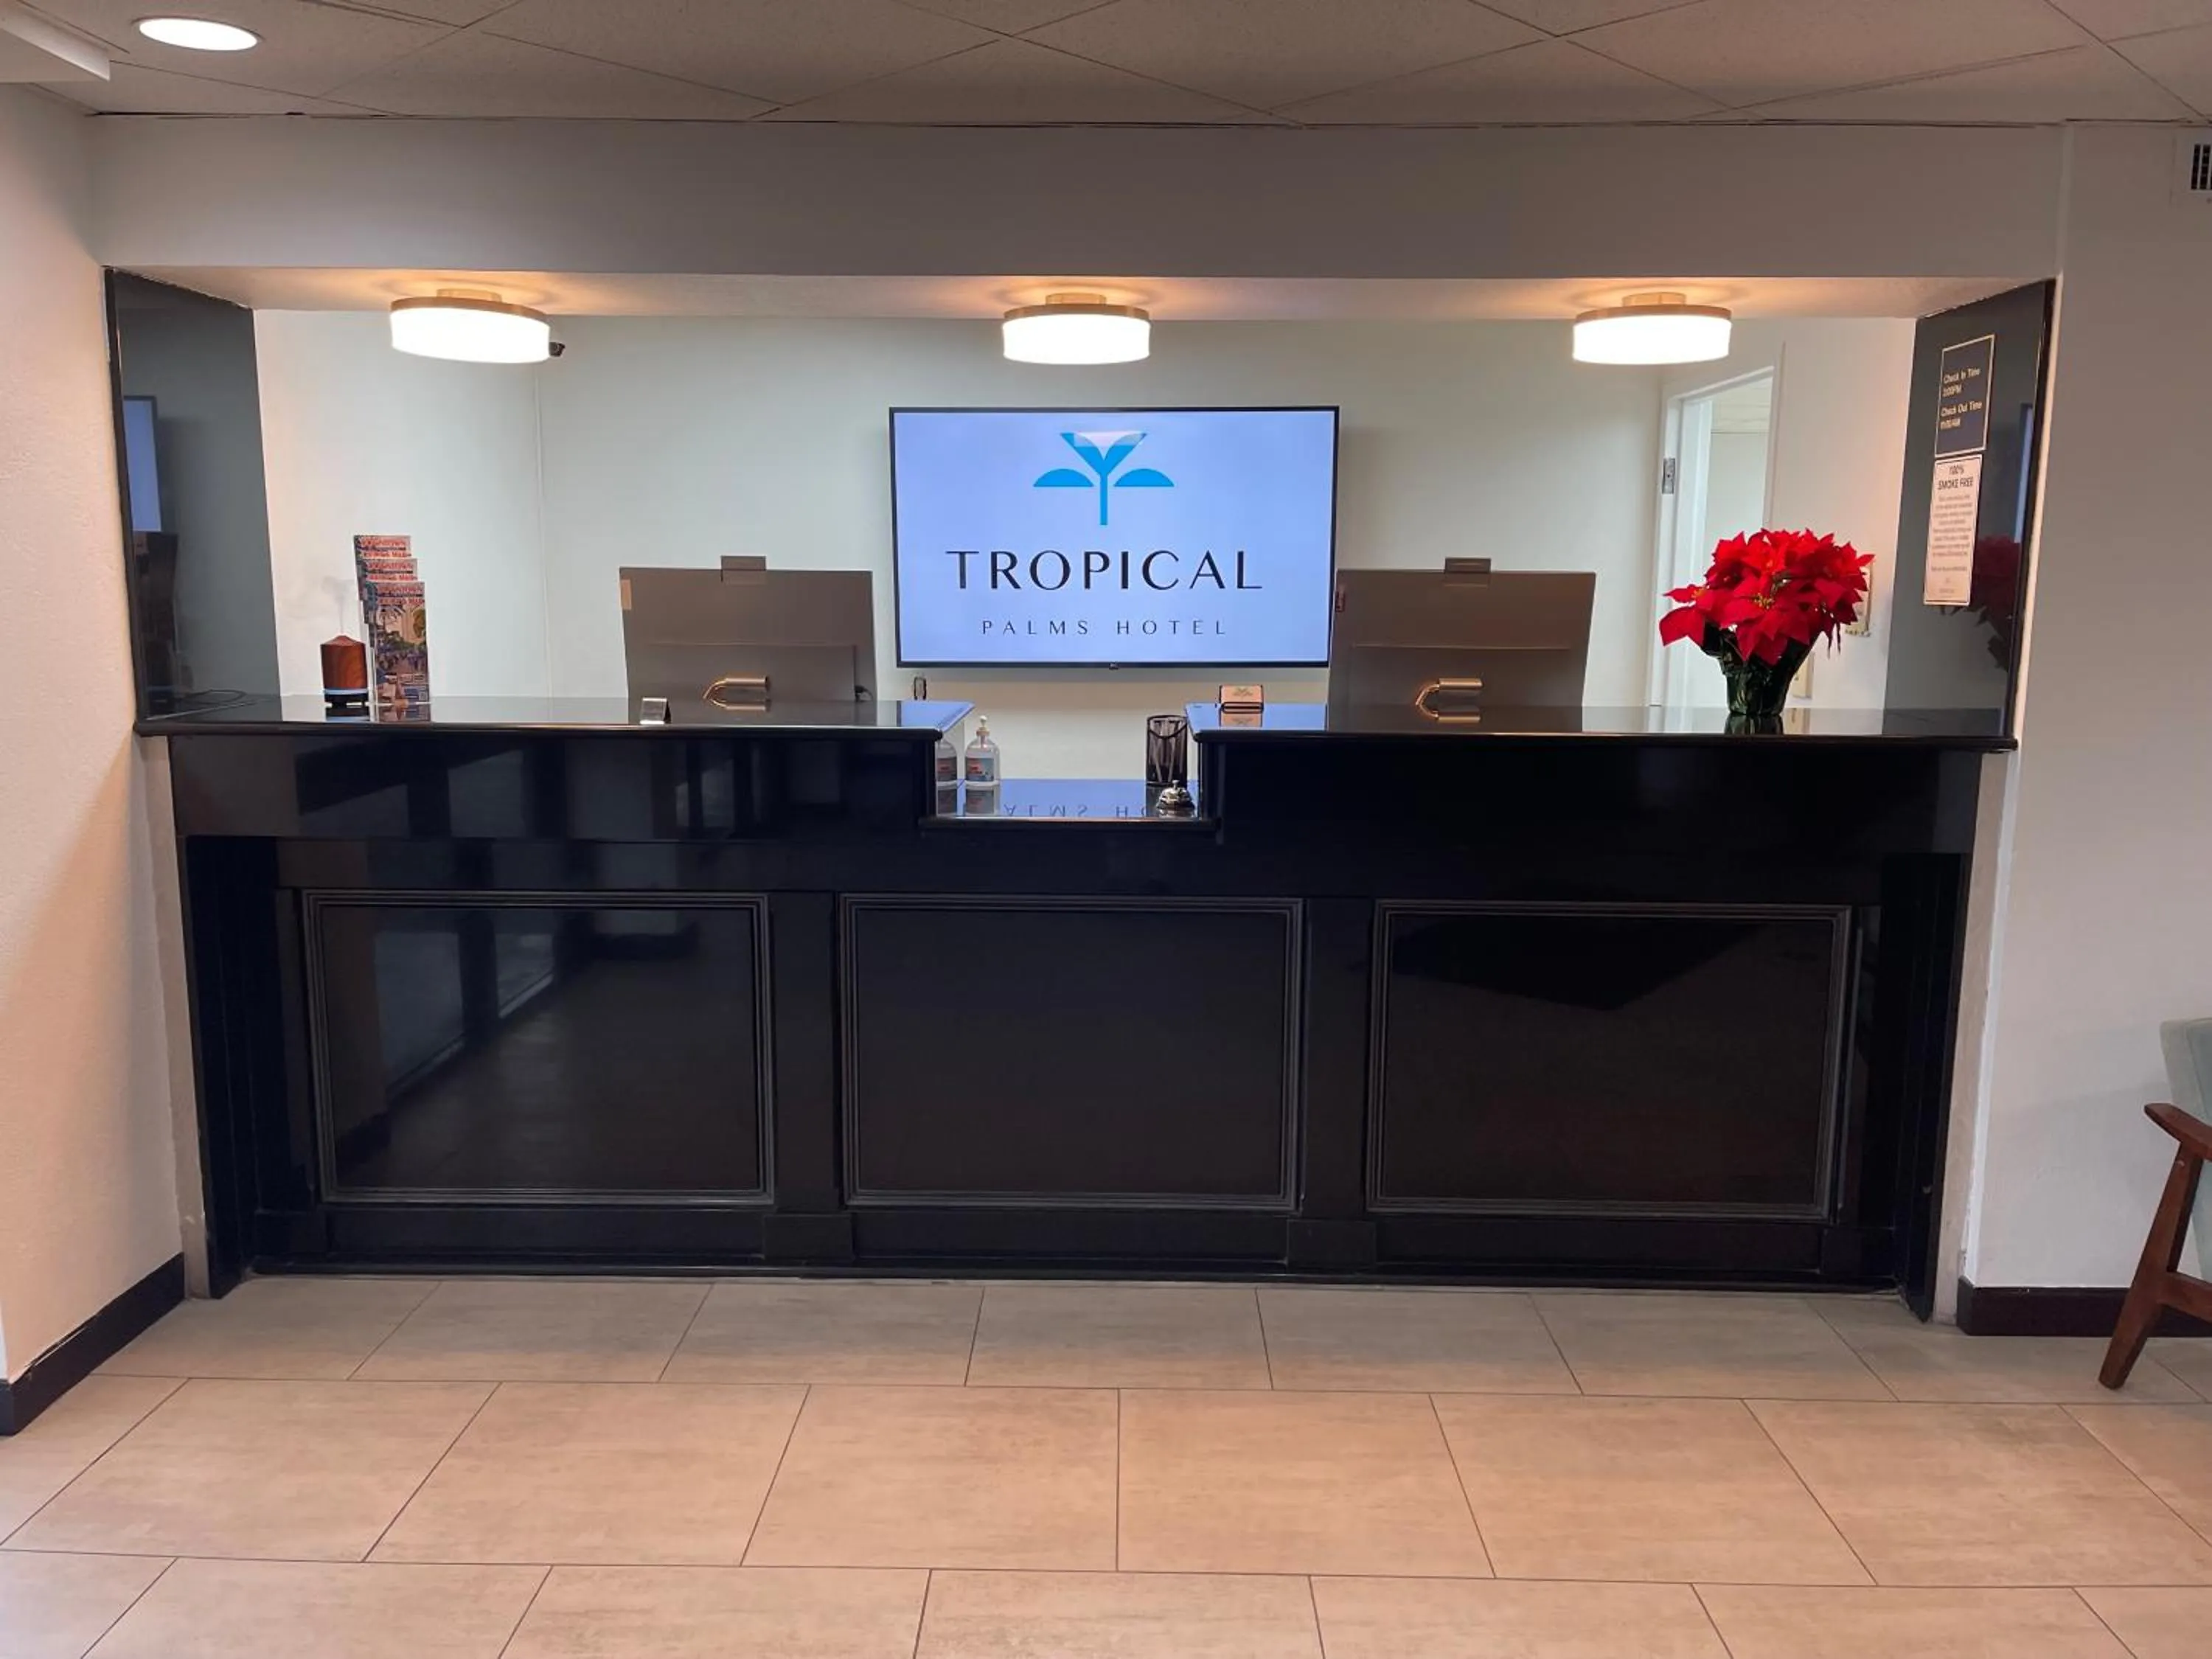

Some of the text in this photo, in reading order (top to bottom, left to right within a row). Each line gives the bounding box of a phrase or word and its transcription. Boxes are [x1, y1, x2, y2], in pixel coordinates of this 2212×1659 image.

[1942, 368, 1981, 383] Check In Time
[1941, 400, 1982, 417] Check Out Time
[1938, 476, 1974, 490] SMOKE FREE
[945, 550, 1262, 591] TROPICAL
[982, 620, 1226, 636] PALMS HOTEL
